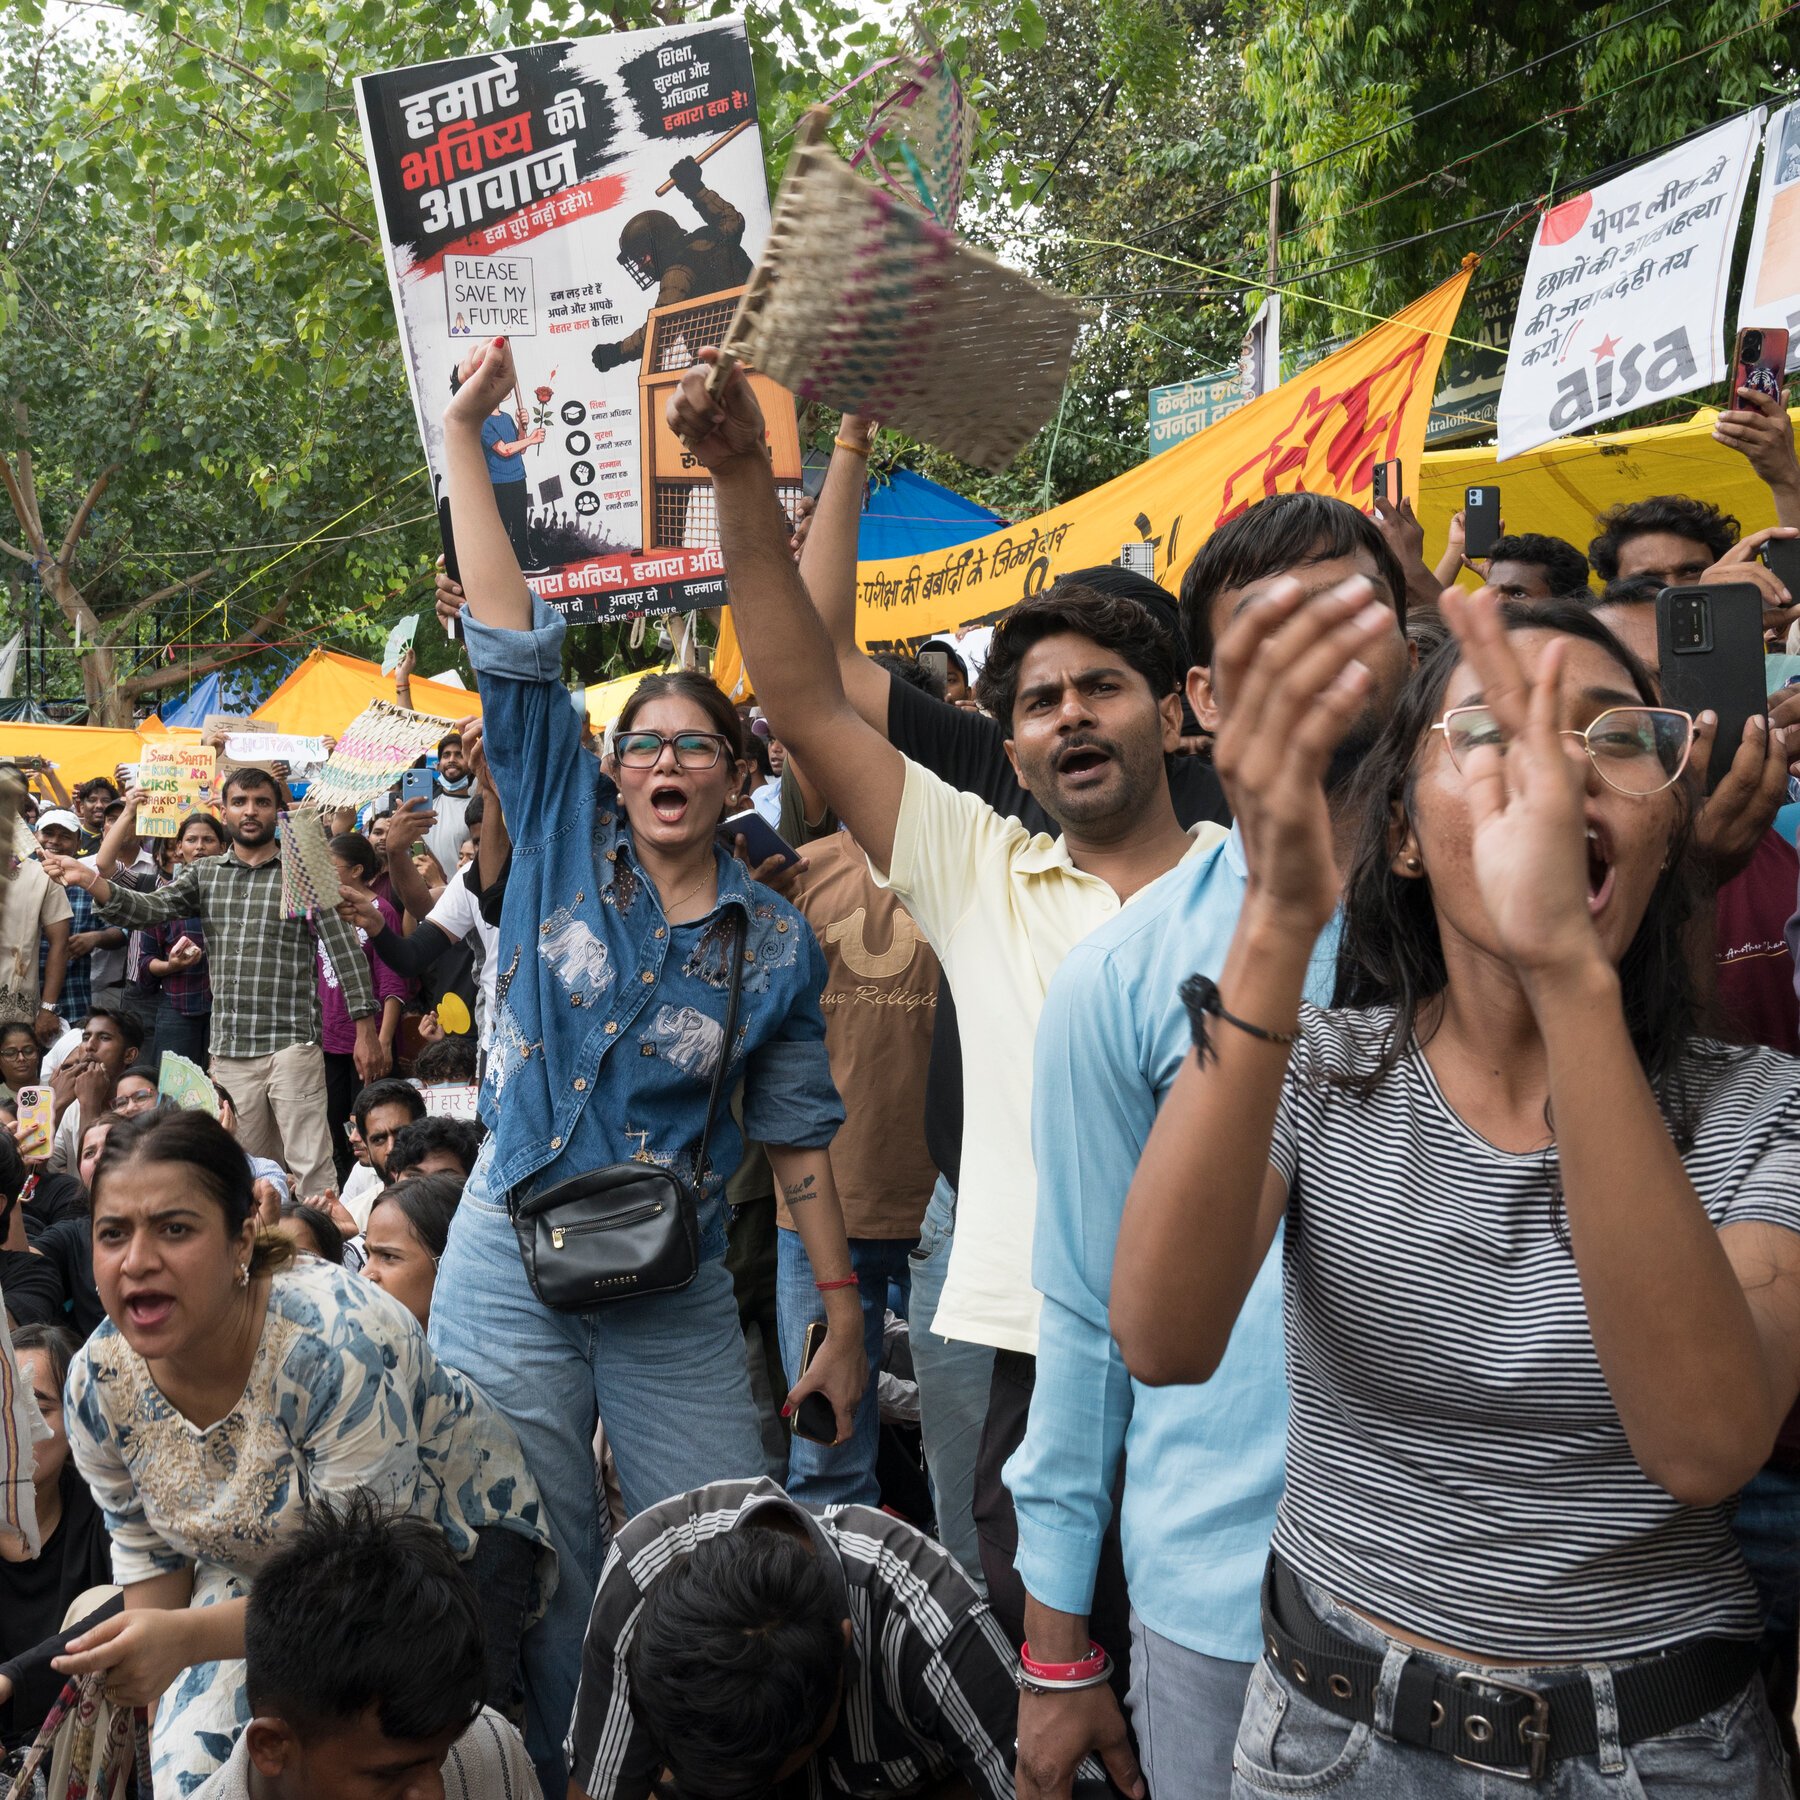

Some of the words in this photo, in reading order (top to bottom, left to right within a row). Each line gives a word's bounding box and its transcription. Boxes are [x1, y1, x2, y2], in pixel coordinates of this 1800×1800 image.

[657, 45, 697, 69] शिक्षा,
[653, 69, 687, 93] सुरक्षा
[689, 61, 710, 79] और
[399, 54, 519, 139] हमारे
[661, 83, 709, 109] अधिकार
[662, 105, 705, 131] हमारा
[706, 97, 730, 117] हक
[400, 111, 533, 190] भविष्य
[543, 88, 587, 136] की
[419, 139, 578, 234] आवाज़
[483, 223, 508, 244] हम
[529, 201, 557, 227] नहीं
[455, 260, 519, 281] PLEASE
[1587, 246, 1620, 276] की
[455, 284, 498, 303] SAVE
[504, 286, 527, 303] MY
[550, 290, 564, 302] हम
[582, 285, 594, 296] रहे
[1525, 303, 1557, 337] की
[1658, 244, 1699, 278] तय
[469, 307, 529, 325] FUTURE
[548, 304, 568, 318] अपने
[571, 301, 586, 315] और
[589, 298, 613, 313] आपके
[548, 322, 572, 335] बेहतर
[573, 319, 590, 332] कल
[591, 316, 600, 329] के
[1549, 325, 1698, 432] aisa
[1156, 383, 1207, 415] केन्द्रीय
[1153, 408, 1208, 440] जनता
[524, 573, 564, 595] मारा
[568, 564, 629, 590] भविष्य,
[631, 557, 685, 581] हमारा
[689, 546, 725, 572] अधि
[863, 571, 903, 612] परीक्षा
[901, 565, 923, 606] की
[967, 547, 988, 586] के
[571, 597, 583, 612] दो
[645, 587, 658, 602] दो
[683, 580, 722, 597] सम्मान
[598, 605, 677, 624] #SaveOurFuture
[140, 779, 179, 792] VIKAS
[190, 768, 208, 780] KA
[151, 805, 165, 814] KA
[138, 815, 177, 834] PATTA
[820, 992, 847, 1005] rue
[854, 985, 938, 1013] Religio
[441, 1094, 461, 1110] हार
